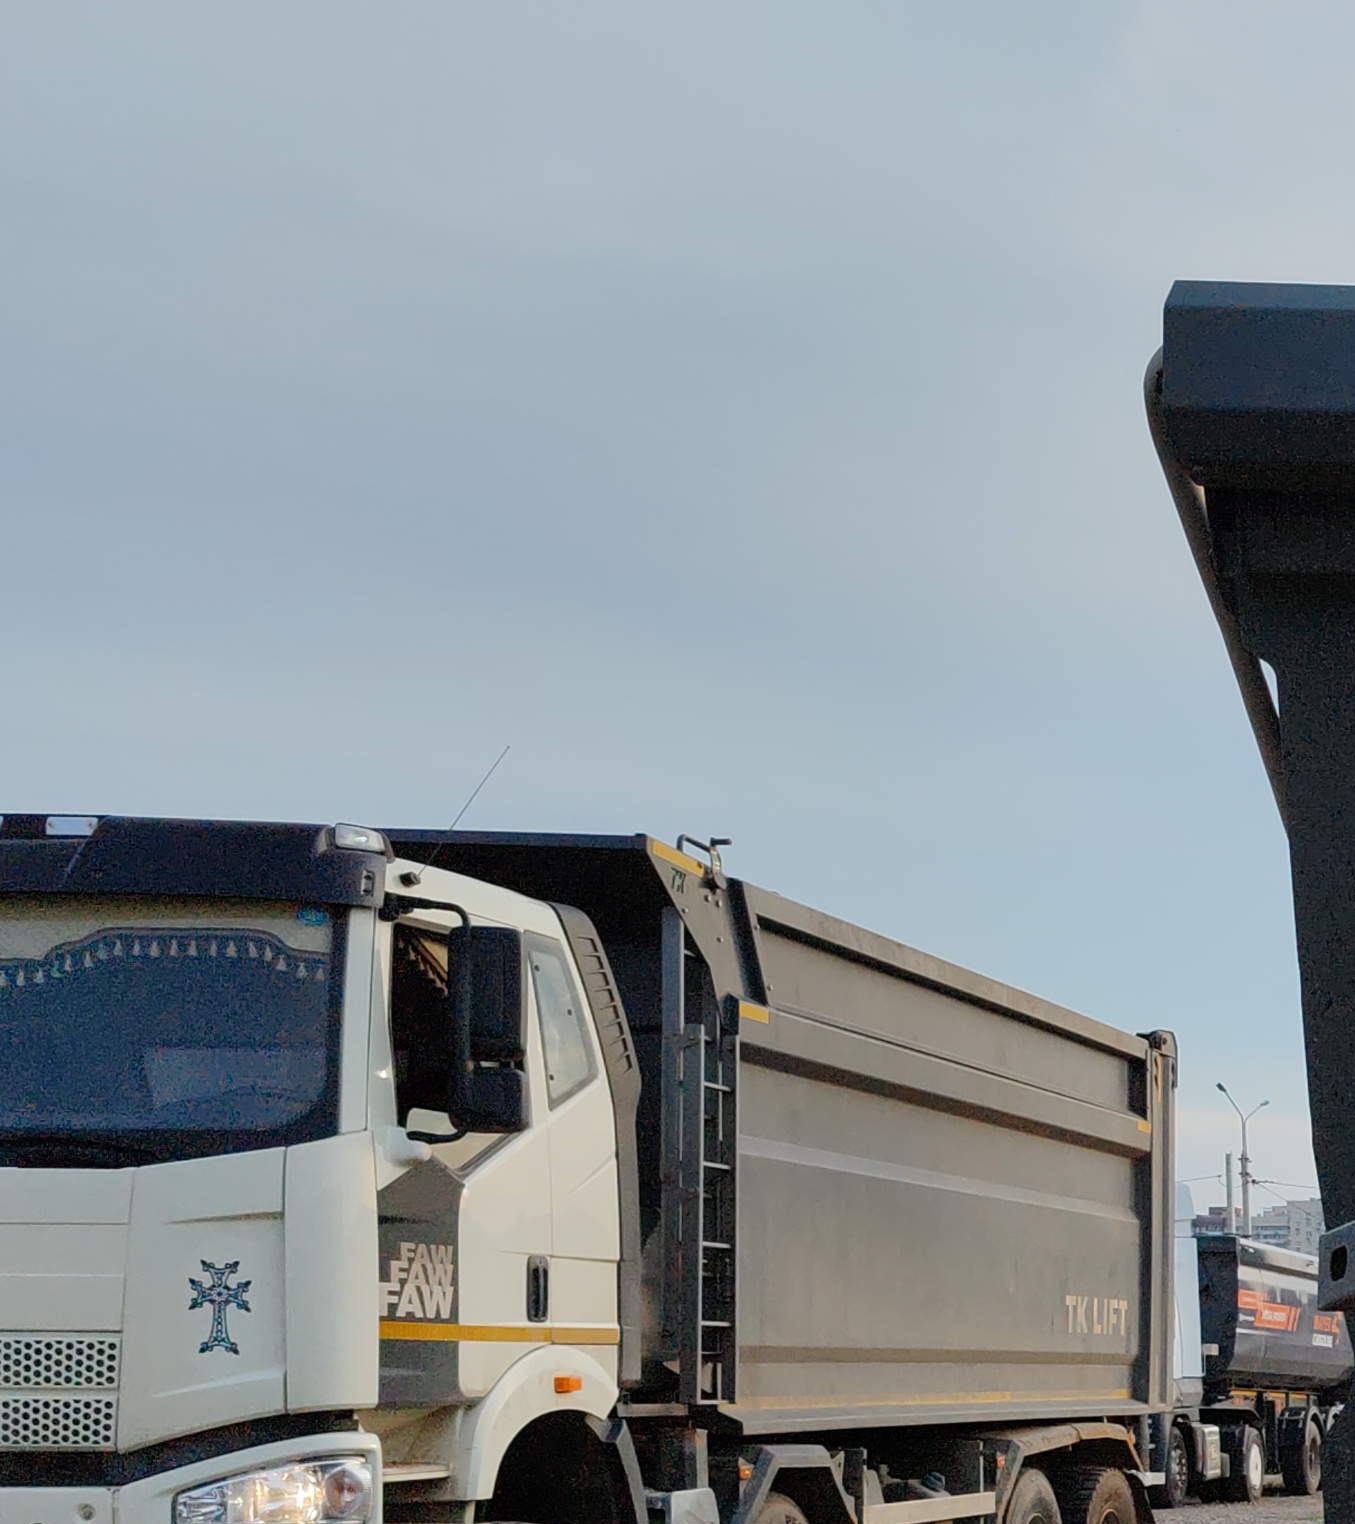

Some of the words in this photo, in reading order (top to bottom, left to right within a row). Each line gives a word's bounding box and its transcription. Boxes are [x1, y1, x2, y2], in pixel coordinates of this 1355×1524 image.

[400, 1241, 454, 1264] FAW
[390, 1260, 454, 1290] FAW
[379, 1281, 454, 1319] FAW
[1065, 1295, 1088, 1334] TK
[1093, 1297, 1128, 1336] LIFT
